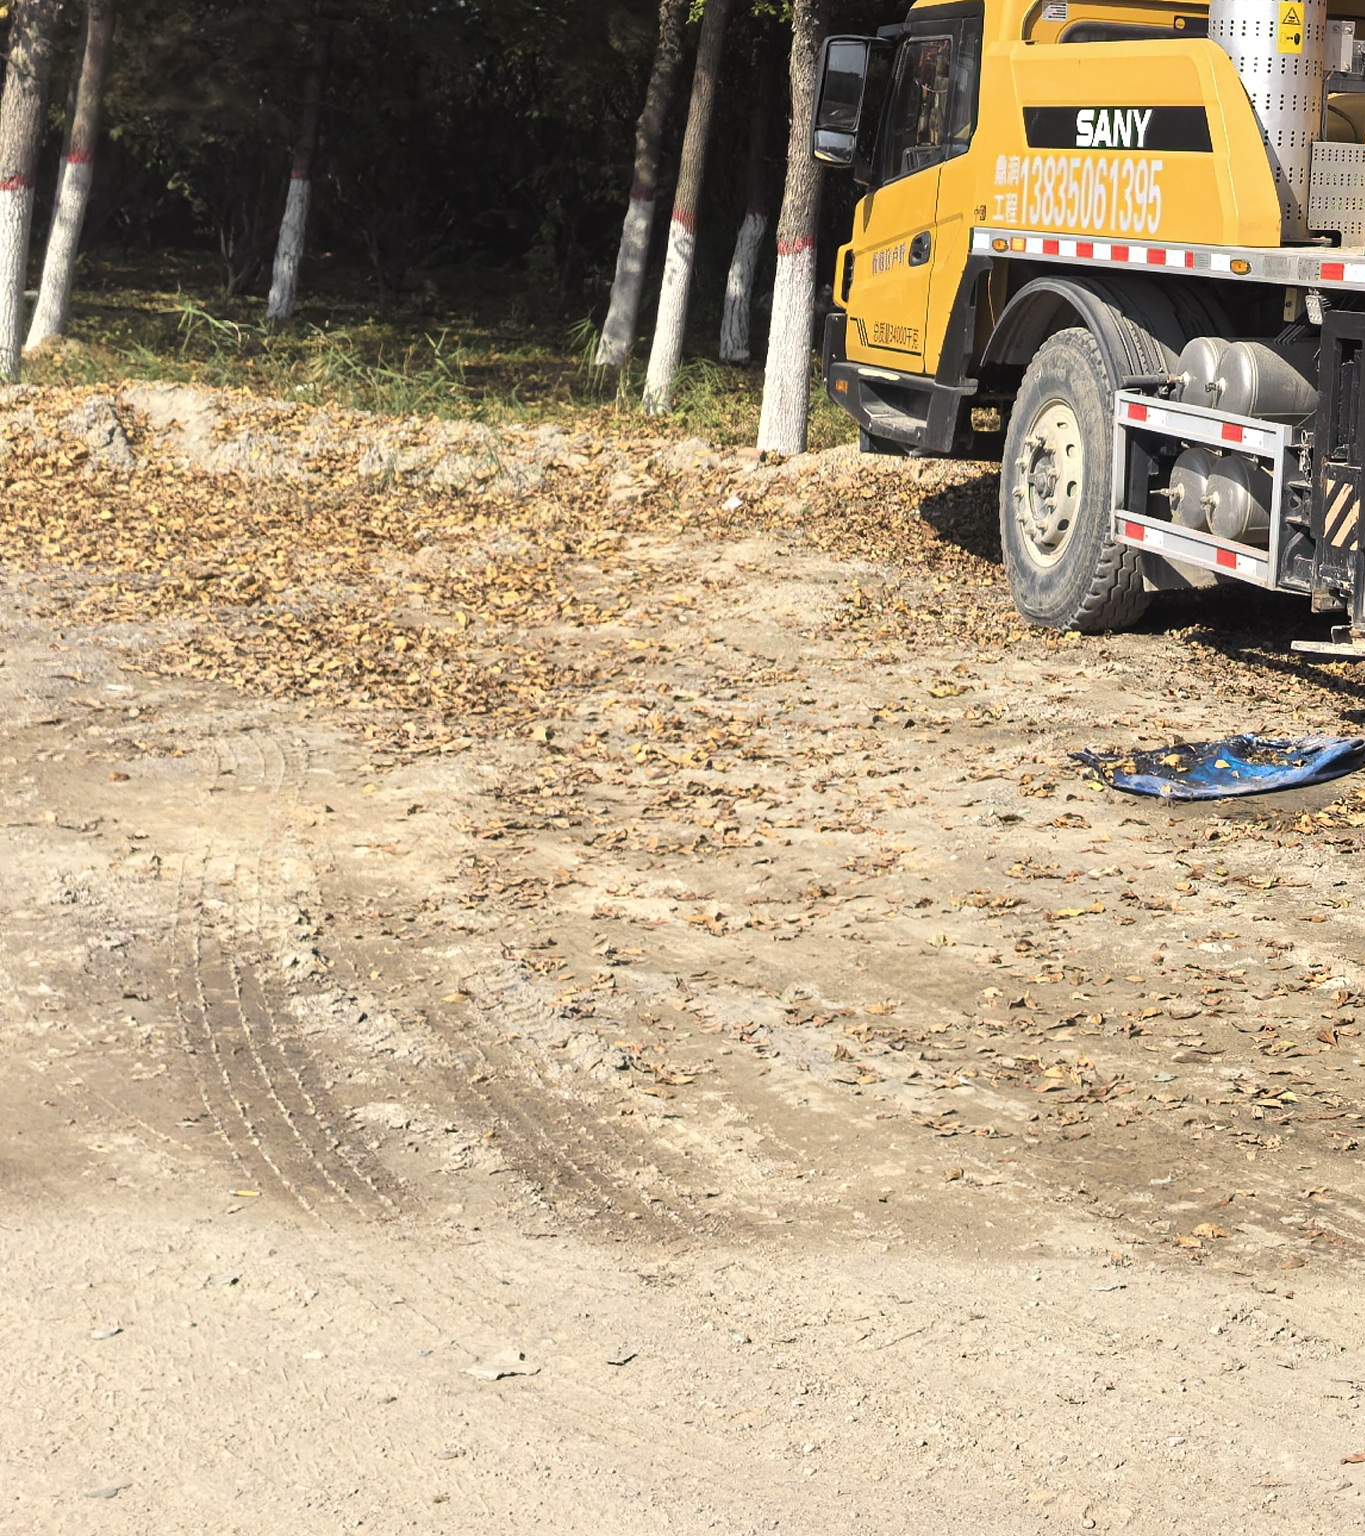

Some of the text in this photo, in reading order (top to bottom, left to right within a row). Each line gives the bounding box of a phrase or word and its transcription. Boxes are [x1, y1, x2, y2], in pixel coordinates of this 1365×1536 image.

[1075, 109, 1152, 148] SANY
[993, 192, 1018, 224] 工程
[1020, 156, 1164, 235] 13835061395
